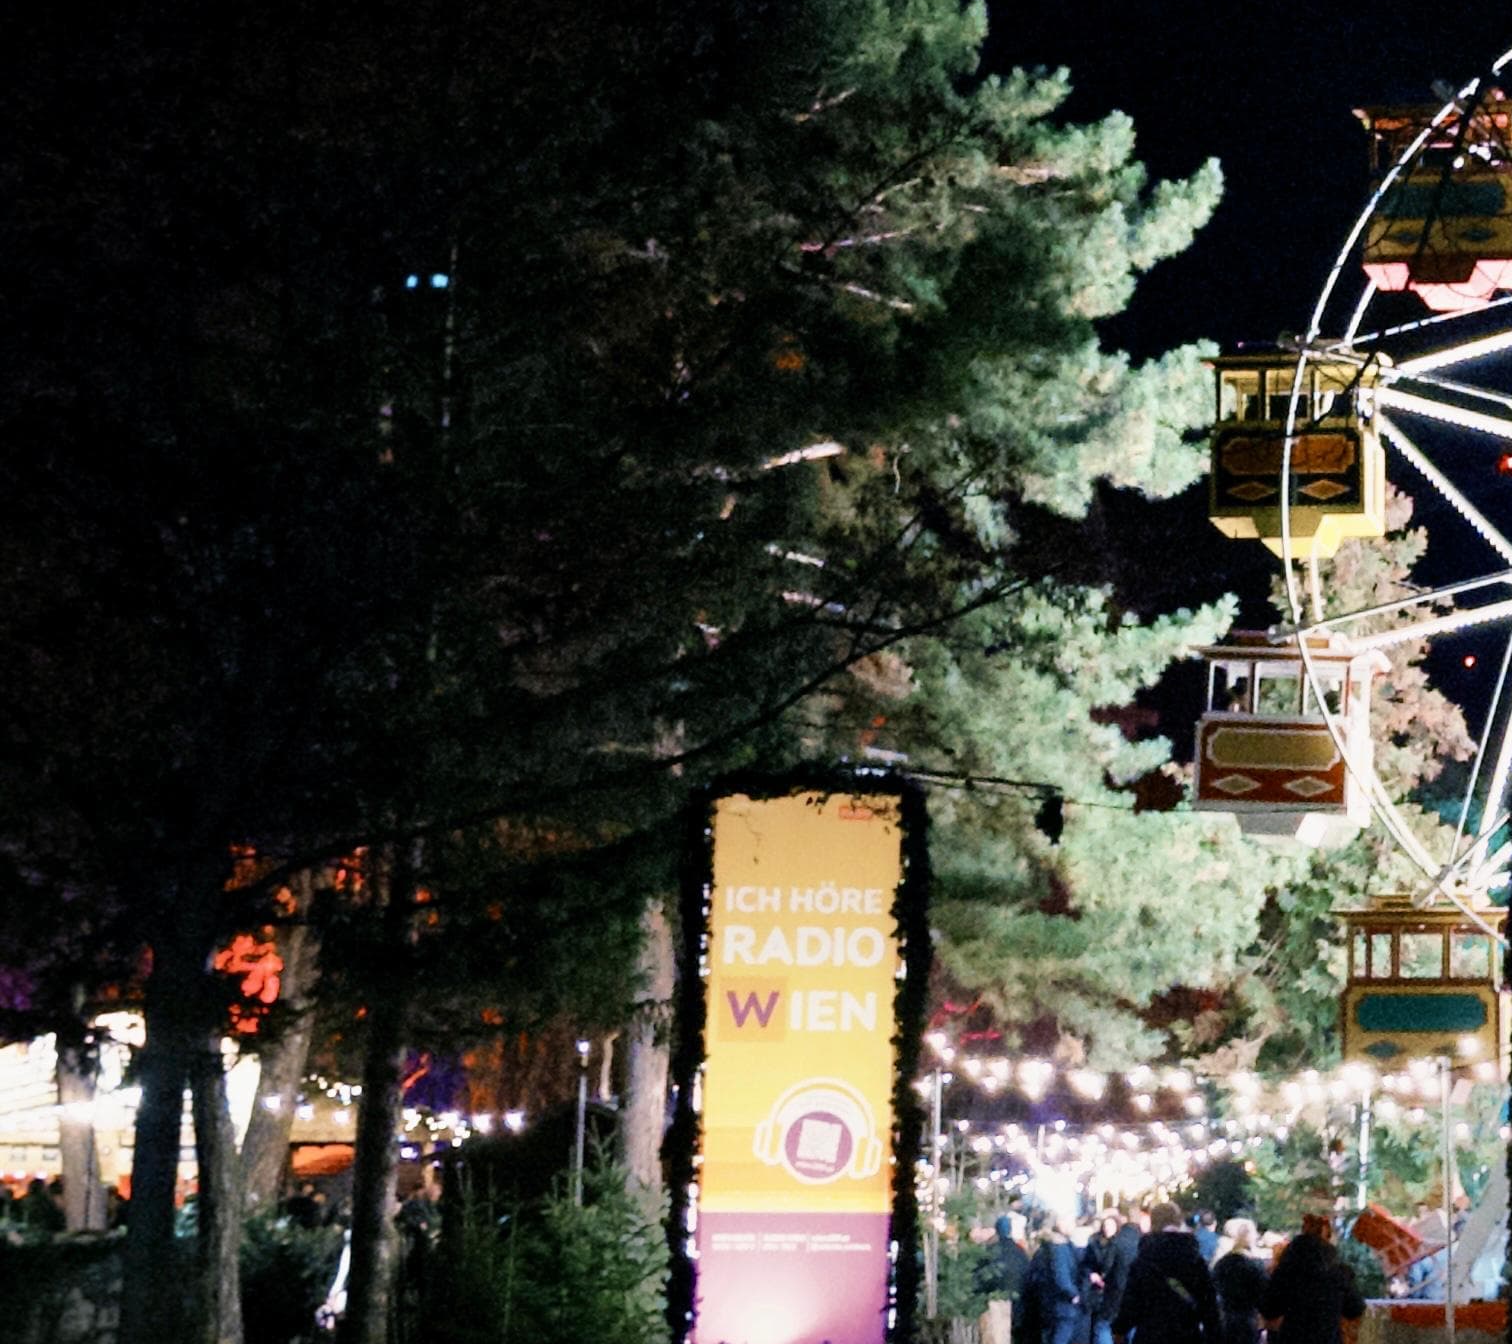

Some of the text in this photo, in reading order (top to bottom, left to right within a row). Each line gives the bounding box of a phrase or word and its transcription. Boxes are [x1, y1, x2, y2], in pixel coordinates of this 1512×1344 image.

[725, 880, 883, 915] ICH HÖRE
[722, 924, 886, 968] RADIO
[726, 989, 877, 1033] WIEN
